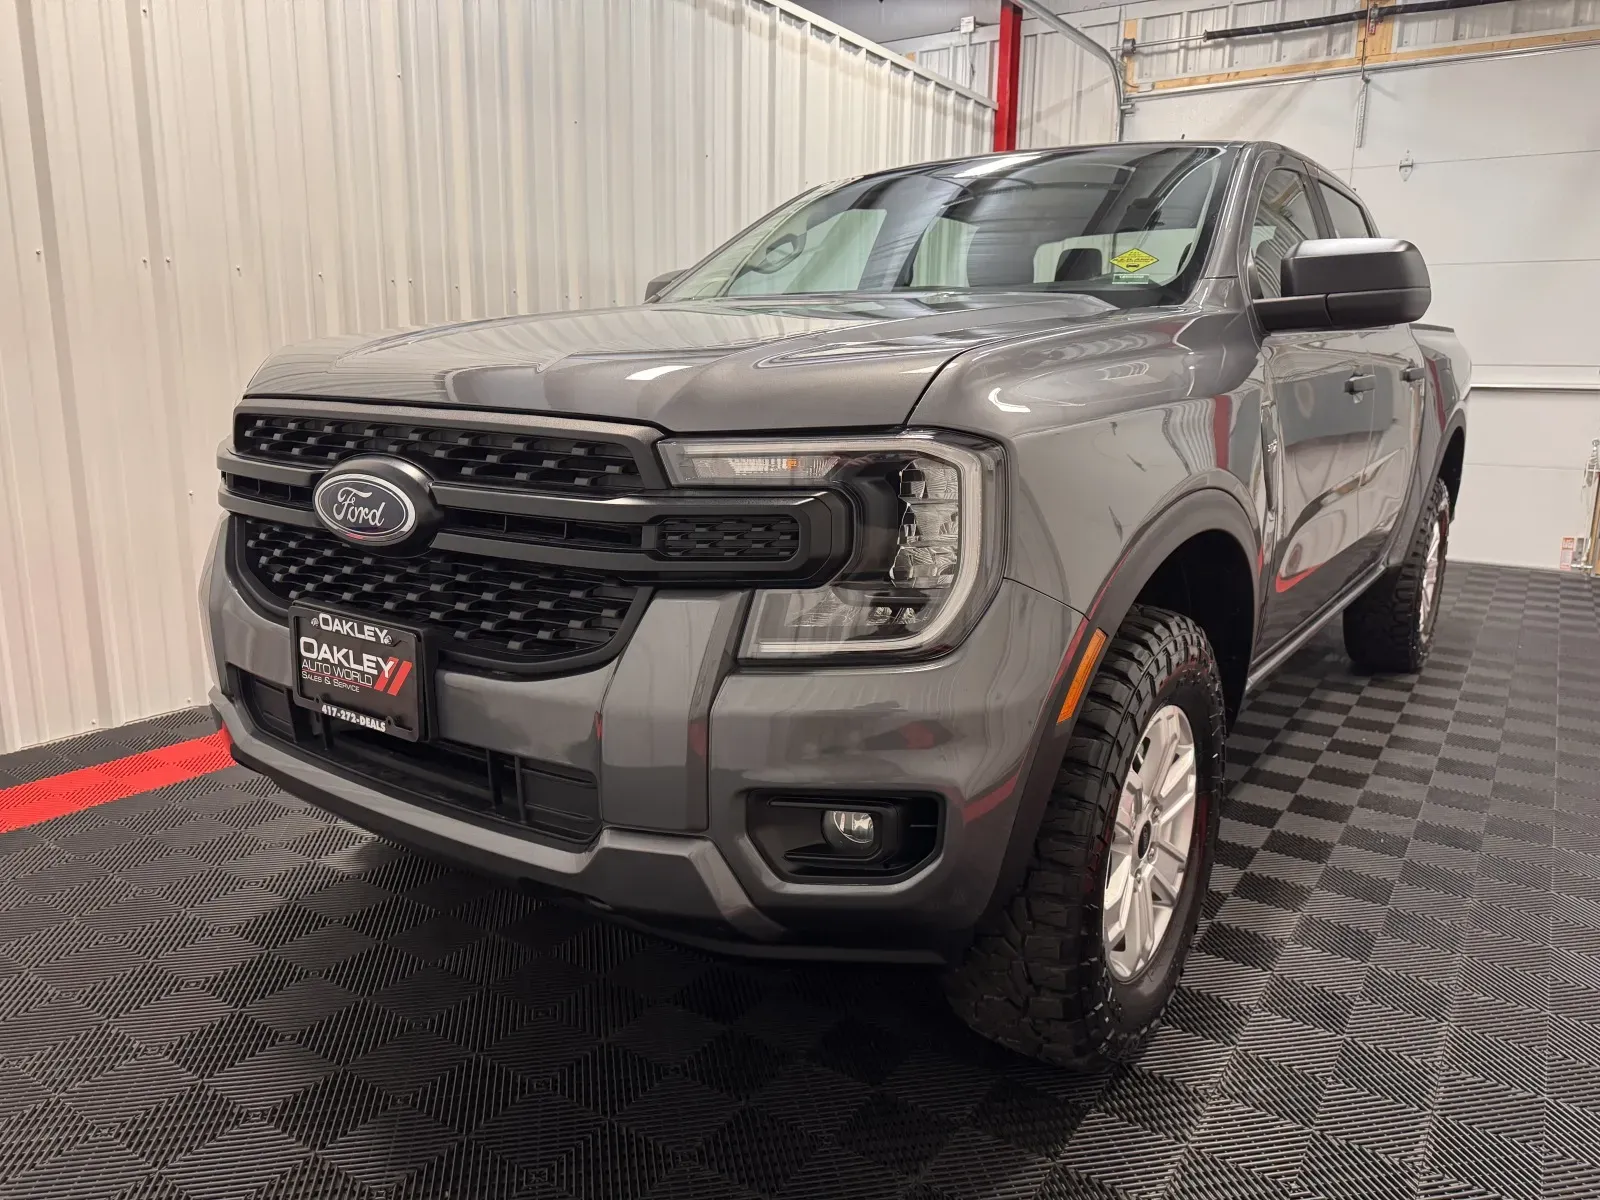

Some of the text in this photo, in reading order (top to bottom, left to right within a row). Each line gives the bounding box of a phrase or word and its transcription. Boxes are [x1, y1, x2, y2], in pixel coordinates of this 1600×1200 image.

[333, 487, 385, 526] Ford
[319, 613, 388, 644] OAKLEY
[300, 636, 394, 678] OAKLEY
[302, 659, 373, 686] AUTO WORLD
[302, 670, 360, 693] SALES & SERVICE
[321, 704, 386, 732] 417-272-DEALS
